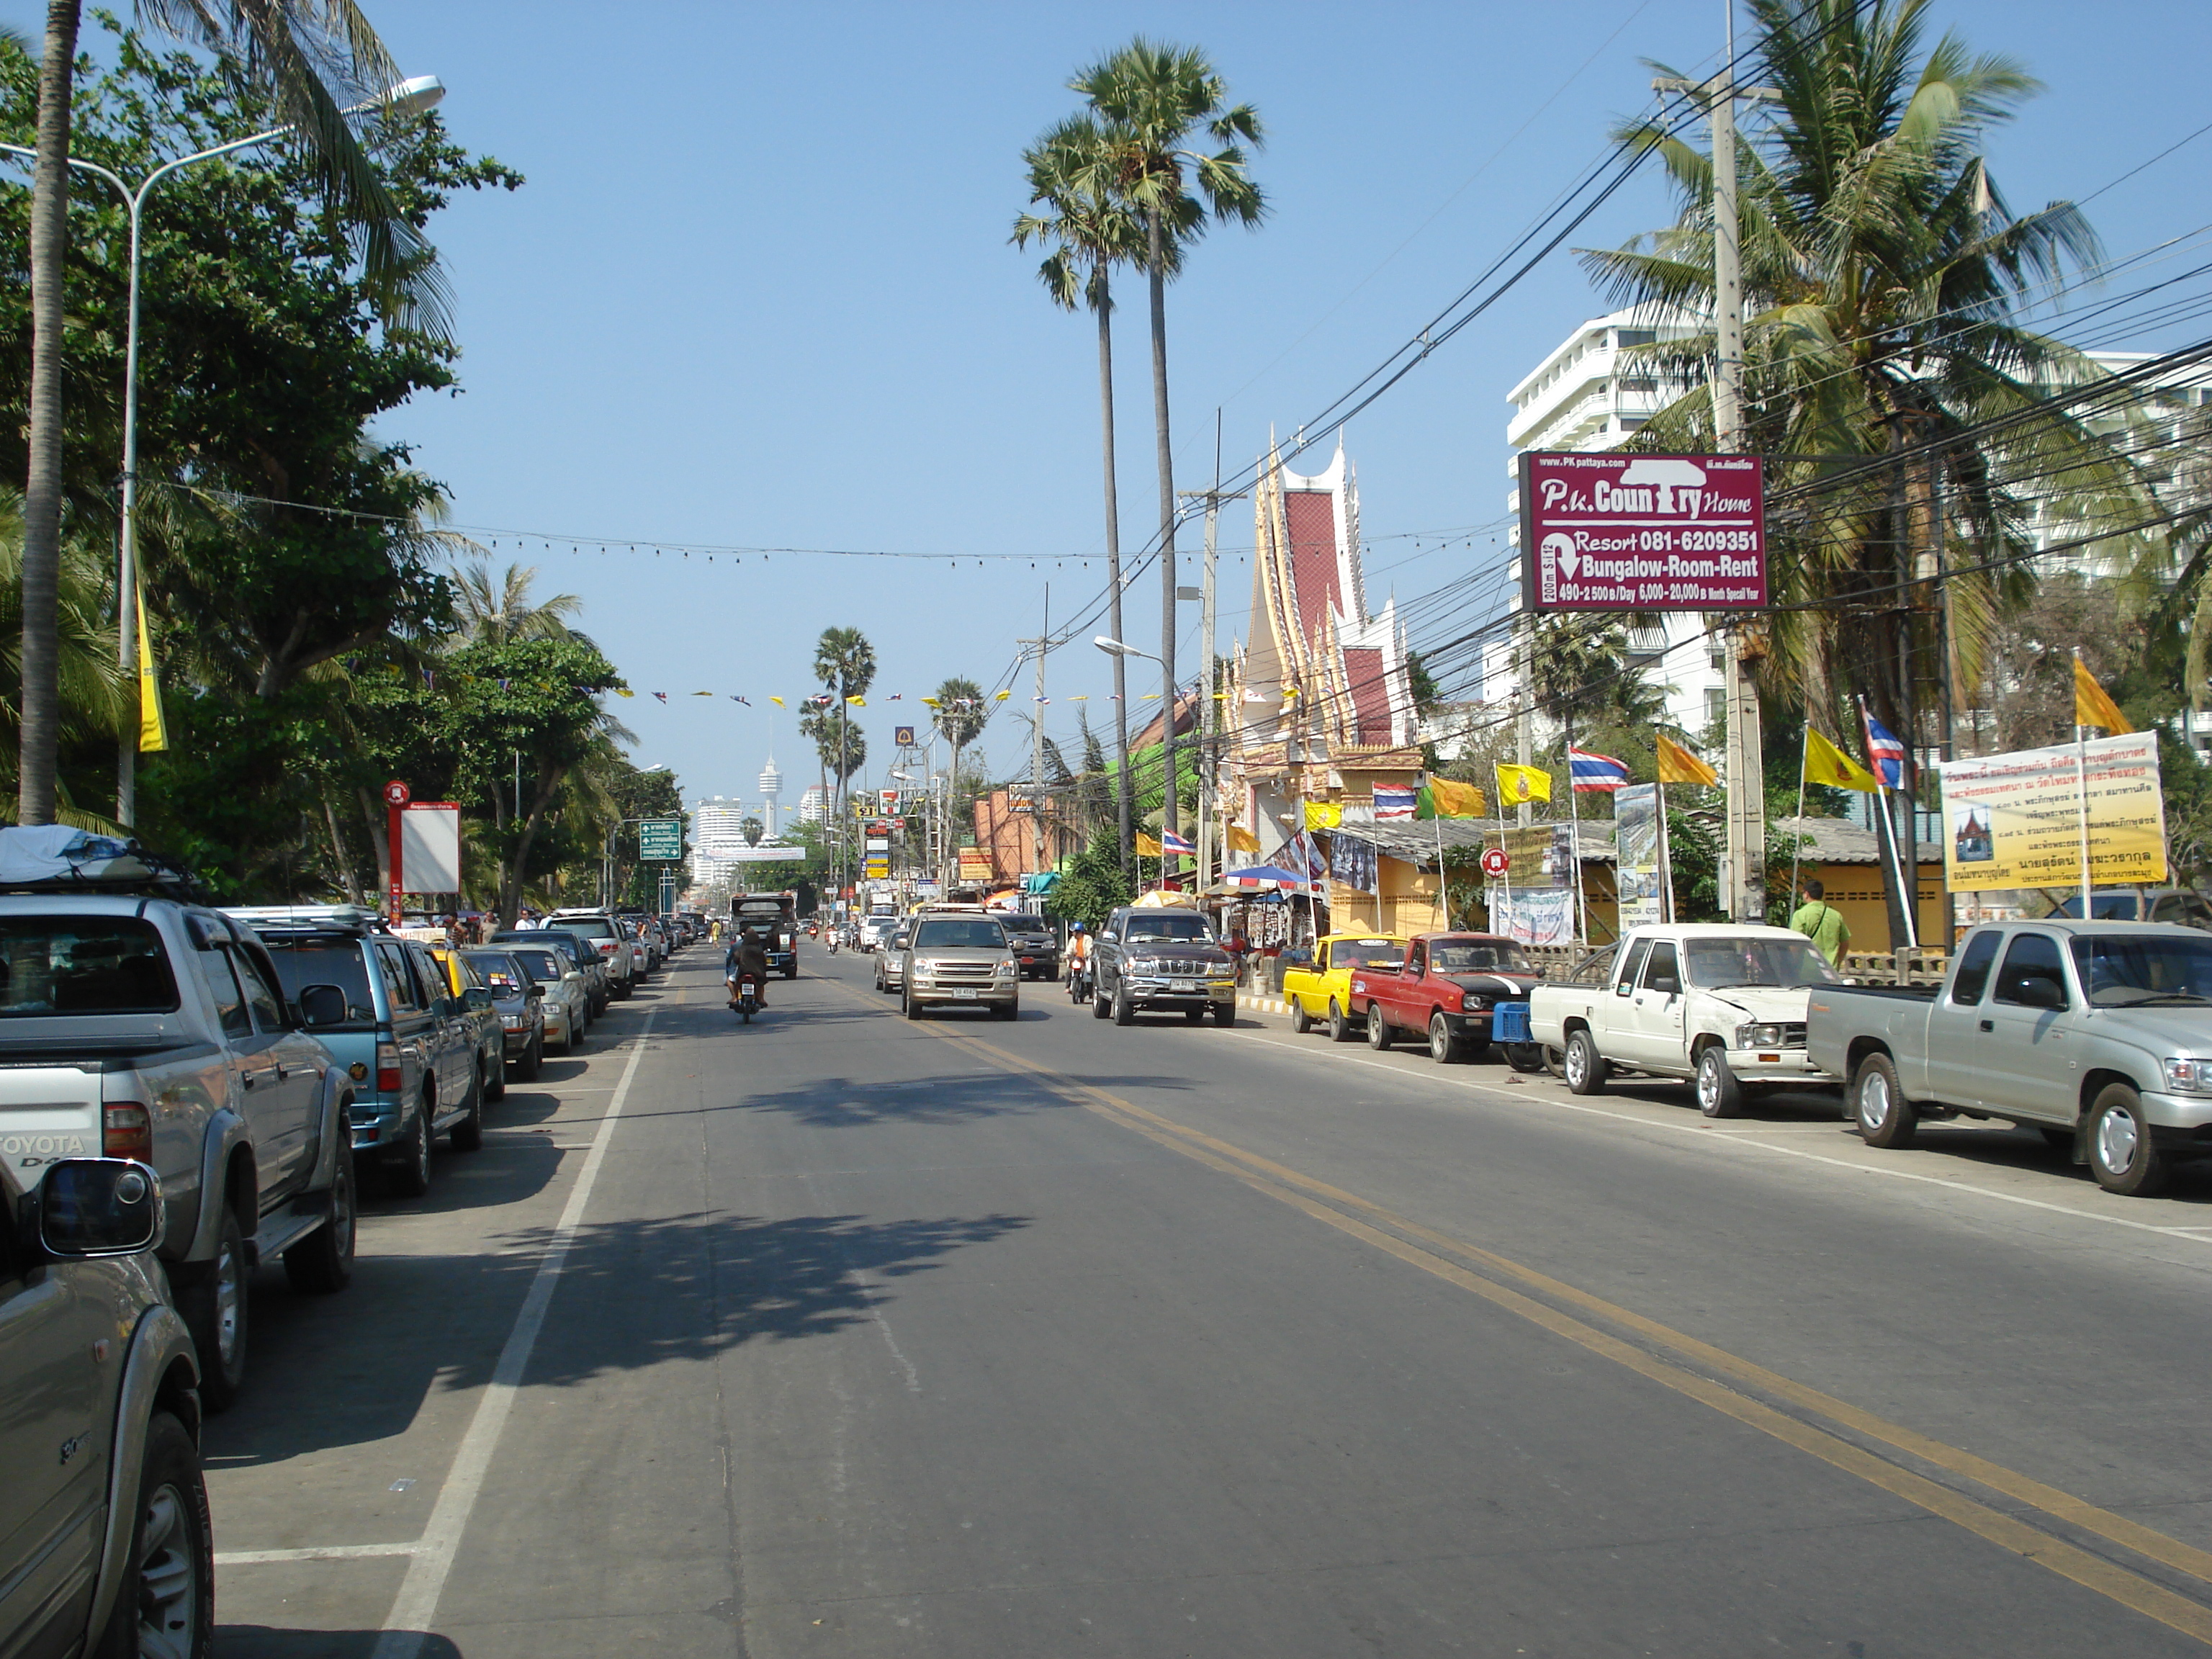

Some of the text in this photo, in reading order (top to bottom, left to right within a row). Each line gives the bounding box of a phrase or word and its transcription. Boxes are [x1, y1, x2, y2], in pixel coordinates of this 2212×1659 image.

[1704, 491, 1753, 513] Home
[1574, 530, 1758, 552] Resort 081-6209351
